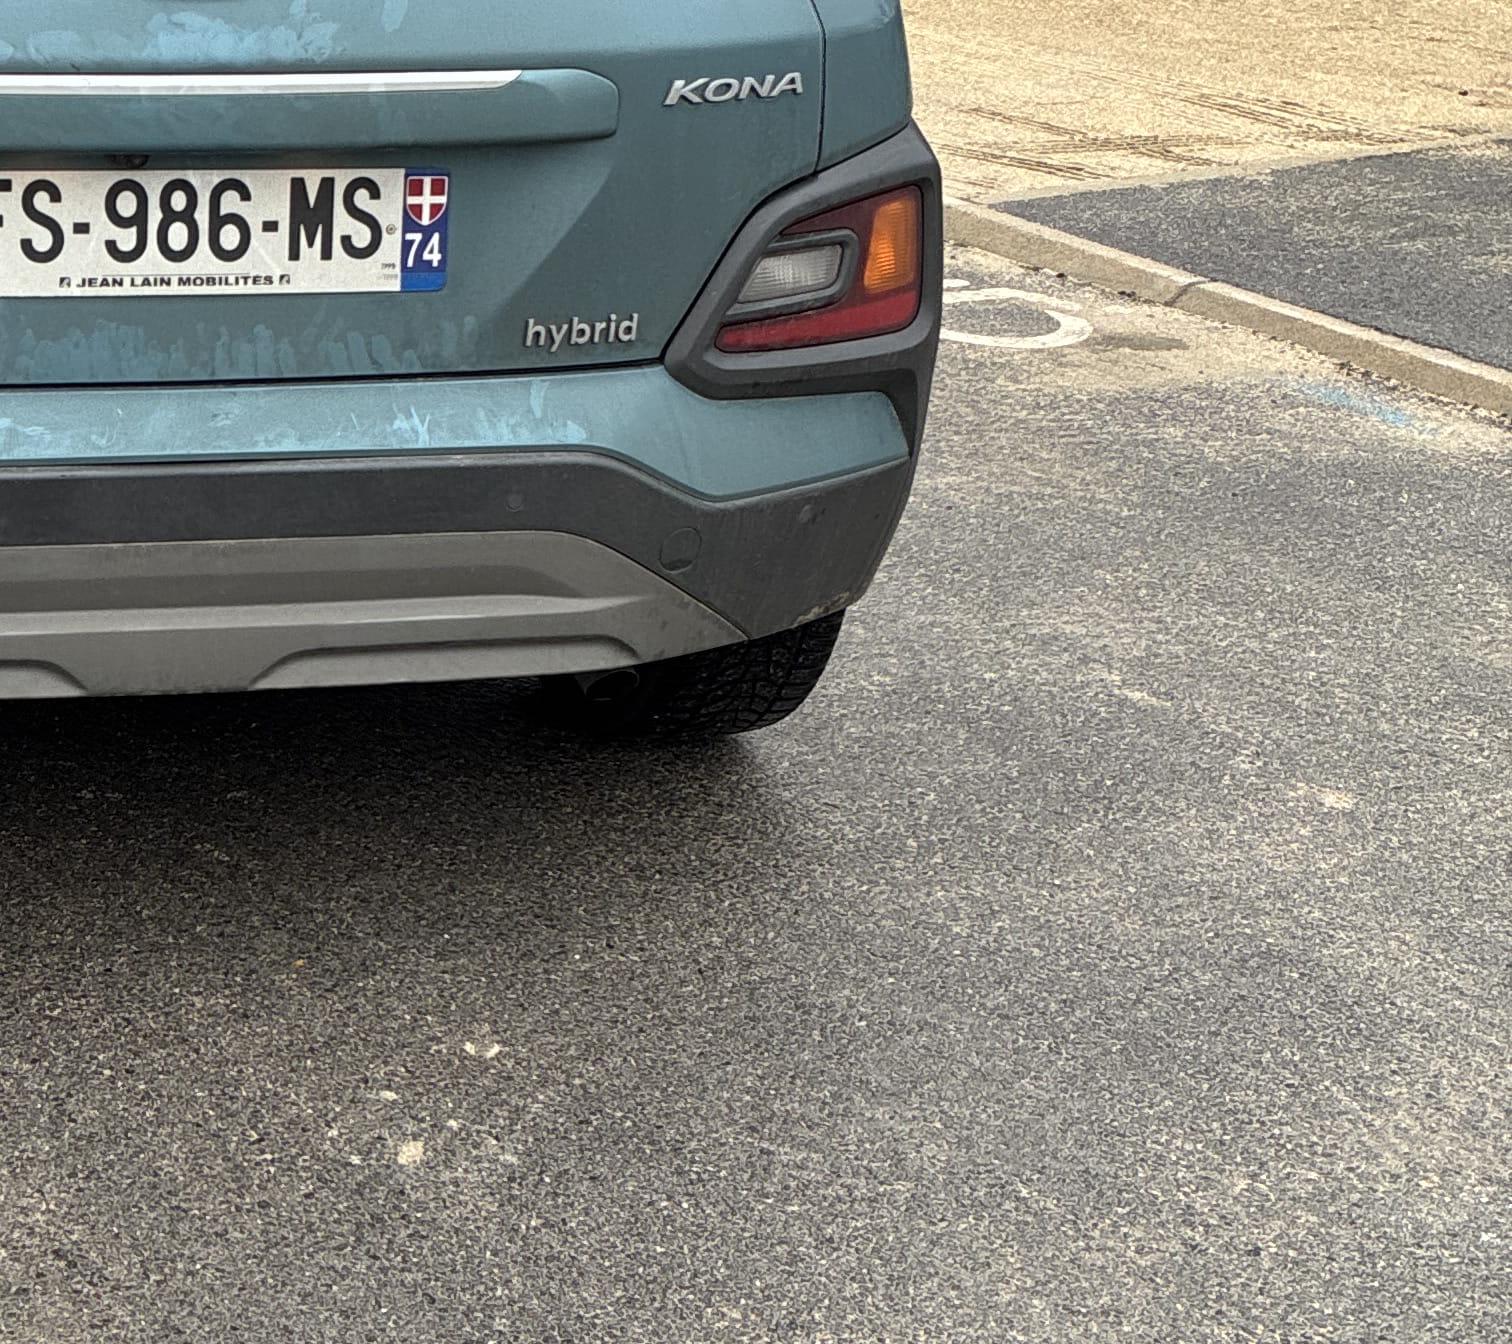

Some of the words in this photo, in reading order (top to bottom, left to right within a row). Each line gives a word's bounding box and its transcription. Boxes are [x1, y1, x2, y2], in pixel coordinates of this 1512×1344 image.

[663, 71, 804, 106] KONA
[404, 232, 443, 268] 74
[76, 277, 124, 288] JEAN
[130, 276, 171, 287] LAIN
[523, 313, 639, 353] hybrid
